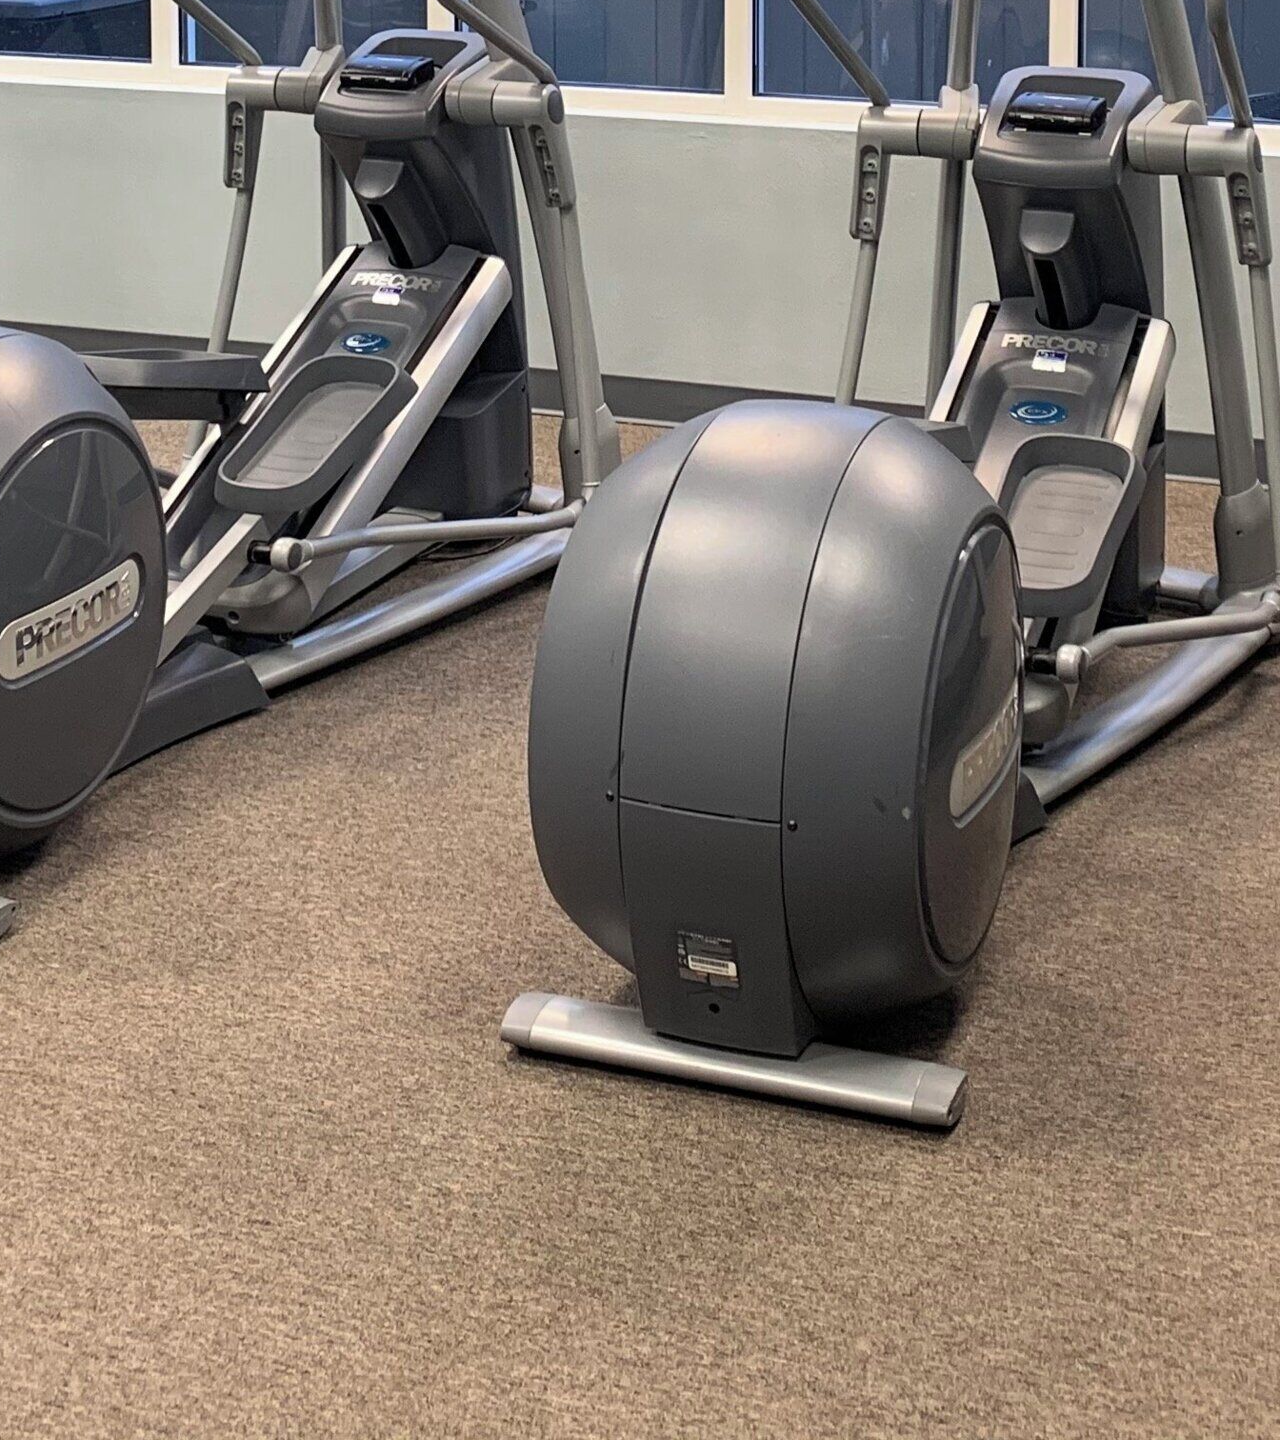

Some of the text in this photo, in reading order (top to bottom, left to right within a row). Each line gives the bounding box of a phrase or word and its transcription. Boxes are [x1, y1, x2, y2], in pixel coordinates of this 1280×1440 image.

[350, 271, 432, 291] PRECOR
[1001, 333, 1095, 356] PRECOR
[15, 580, 122, 667] PRECOR
